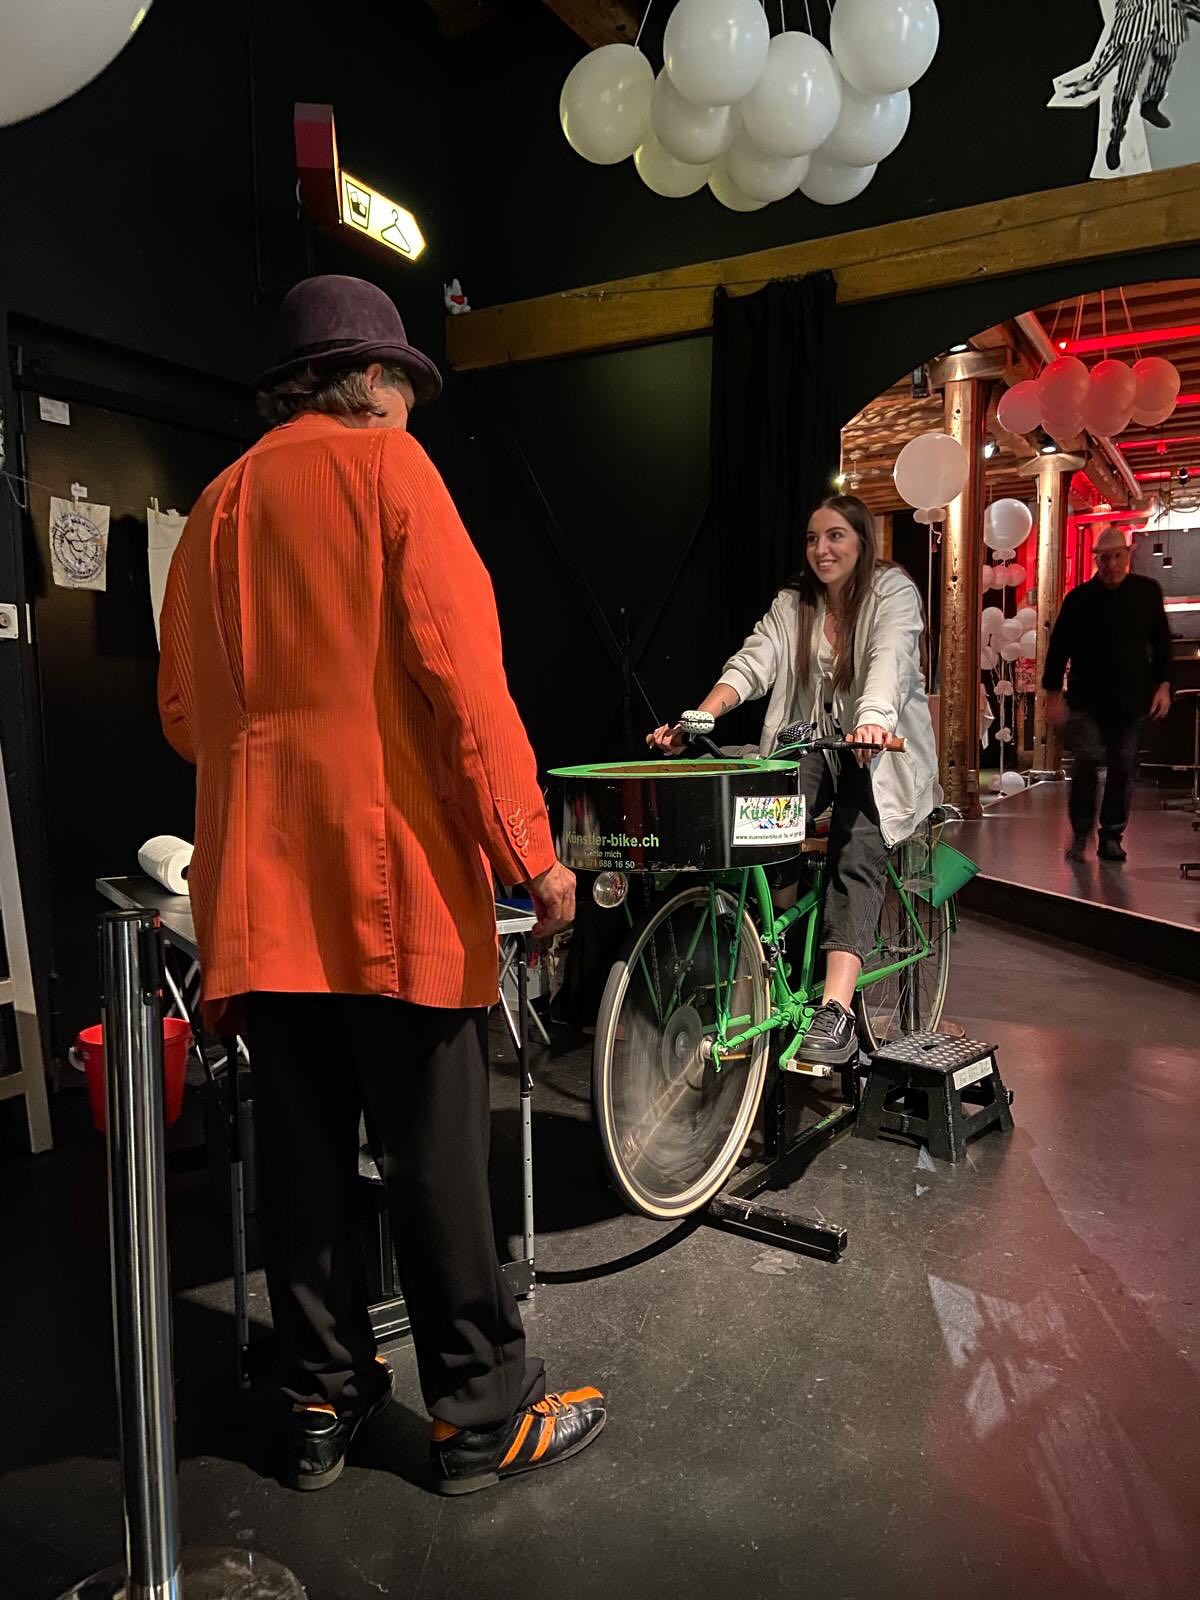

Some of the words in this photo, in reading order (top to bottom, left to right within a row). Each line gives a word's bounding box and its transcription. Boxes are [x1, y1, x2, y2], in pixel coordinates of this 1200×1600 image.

[565, 831, 660, 847] Künstler-bike.ch
[604, 850, 622, 858] mich
[599, 860, 613, 868] 688
[615, 860, 624, 868] 16
[625, 860, 636, 869] 50
